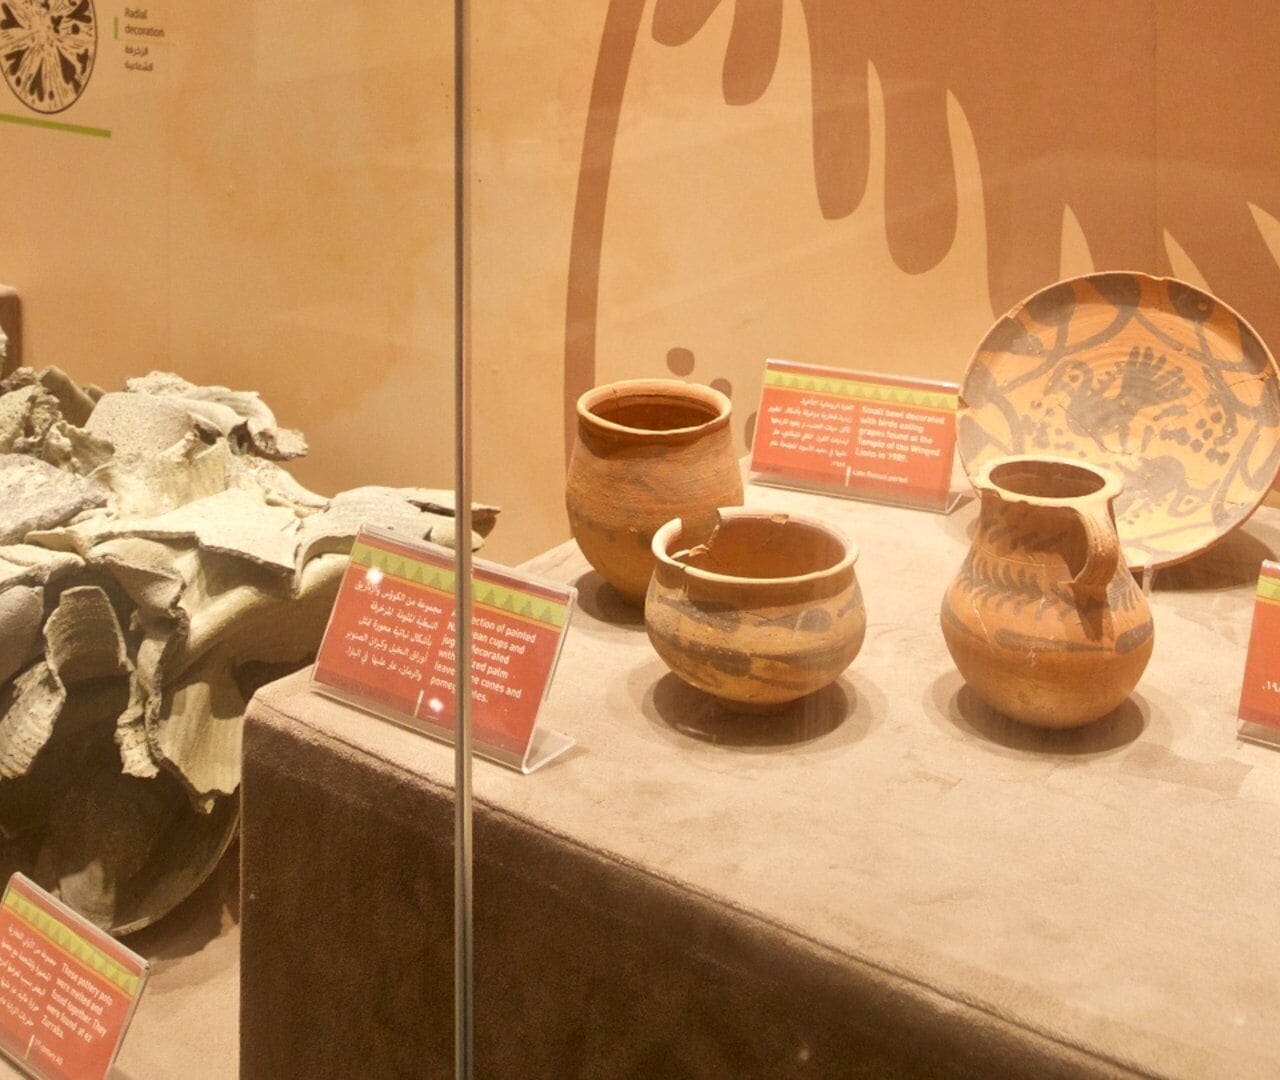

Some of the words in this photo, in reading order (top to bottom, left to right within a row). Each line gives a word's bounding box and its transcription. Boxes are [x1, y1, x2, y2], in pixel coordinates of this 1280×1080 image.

[860, 416, 877, 425] with
[862, 406, 884, 416] Small
[885, 409, 905, 418] bowl
[905, 410, 946, 425] decorated
[496, 623, 506, 634] of
[505, 628, 537, 643] painted
[488, 637, 509, 650] cups
[509, 643, 526, 655] and
[486, 666, 509, 679] palm
[480, 678, 505, 694] cones
[505, 687, 522, 699] and
[56, 977, 71, 993] were
[62, 962, 78, 982] These
[77, 977, 100, 998] pottery
[98, 991, 113, 1006] pots
[46, 1003, 61, 1018] were
[60, 1013, 78, 1032] found
[93, 1018, 108, 1038] They
